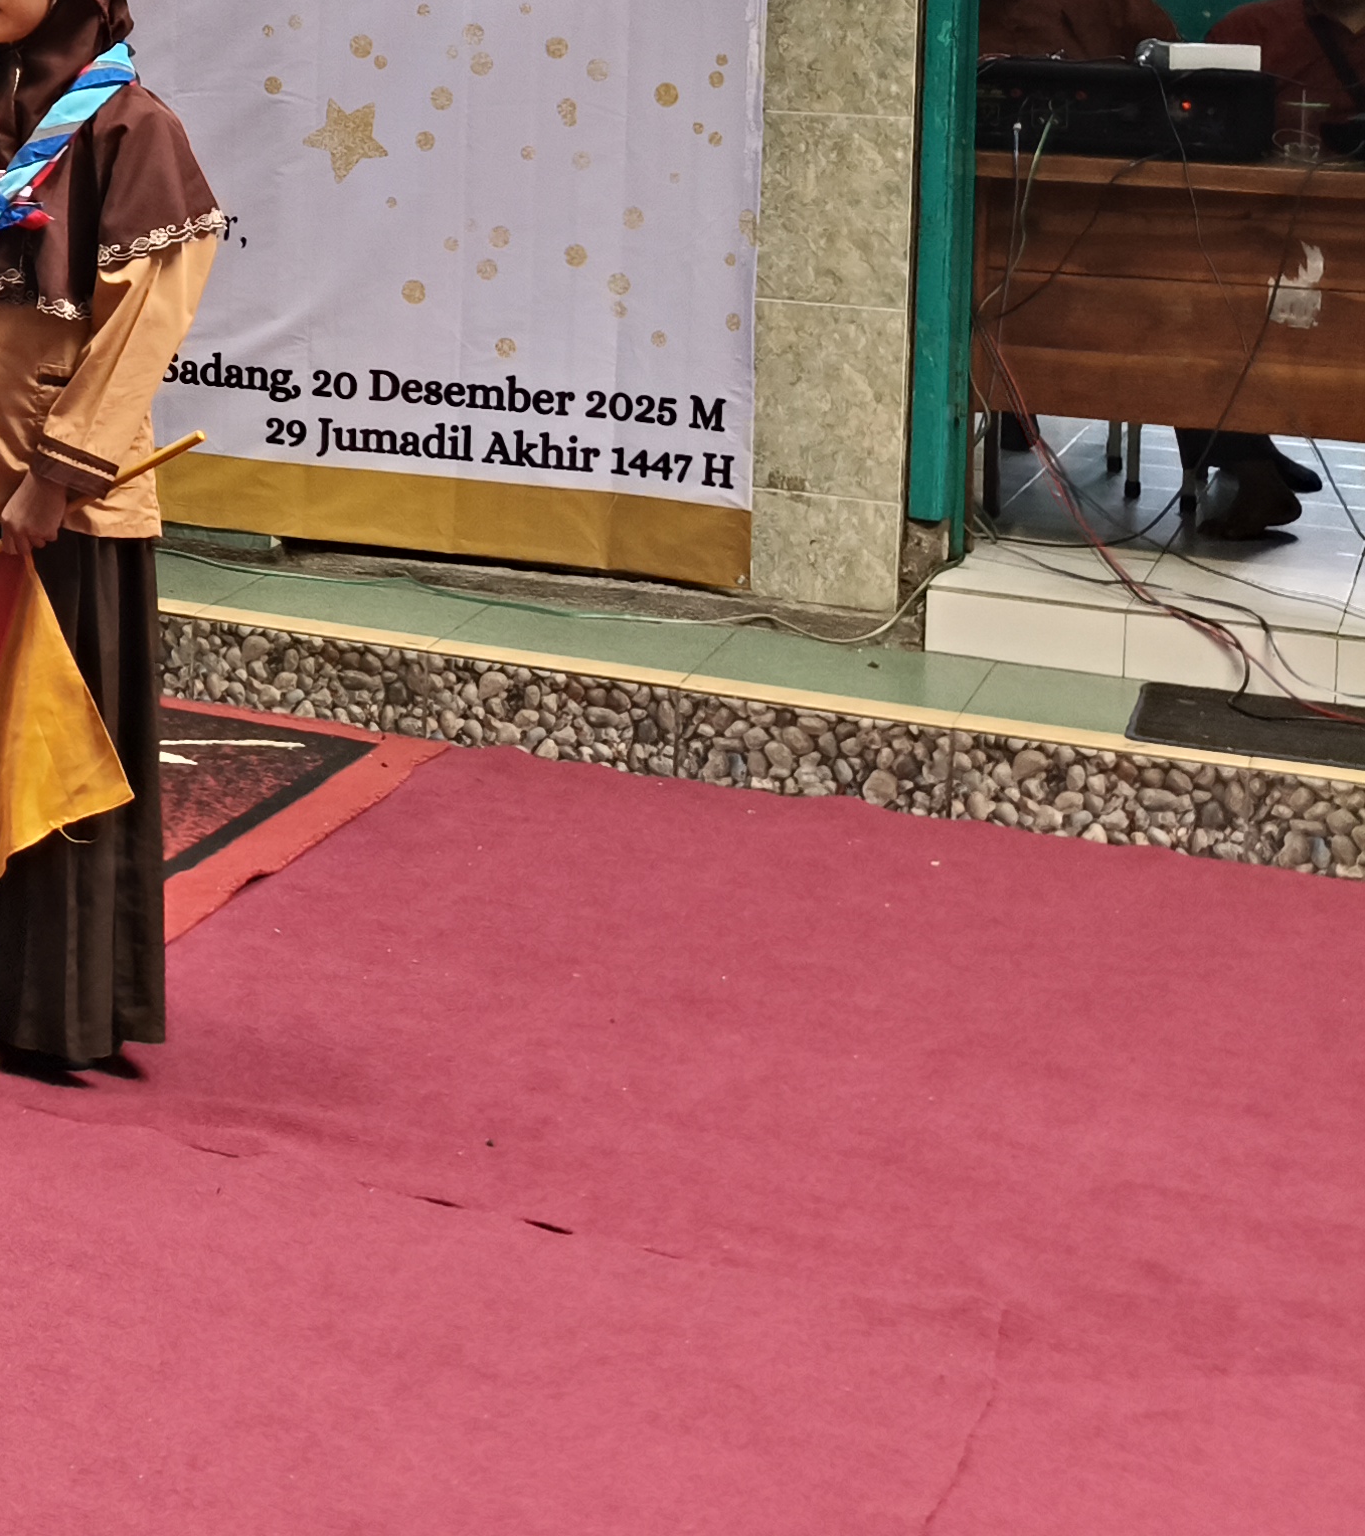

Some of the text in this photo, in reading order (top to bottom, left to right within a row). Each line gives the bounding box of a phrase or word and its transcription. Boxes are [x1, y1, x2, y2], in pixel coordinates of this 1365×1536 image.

[311, 368, 358, 401] 20
[368, 368, 576, 417] Desember
[585, 390, 678, 427] 2025
[689, 394, 728, 434] M
[265, 416, 736, 490] 29 Jumadil Akhir 1447 H
